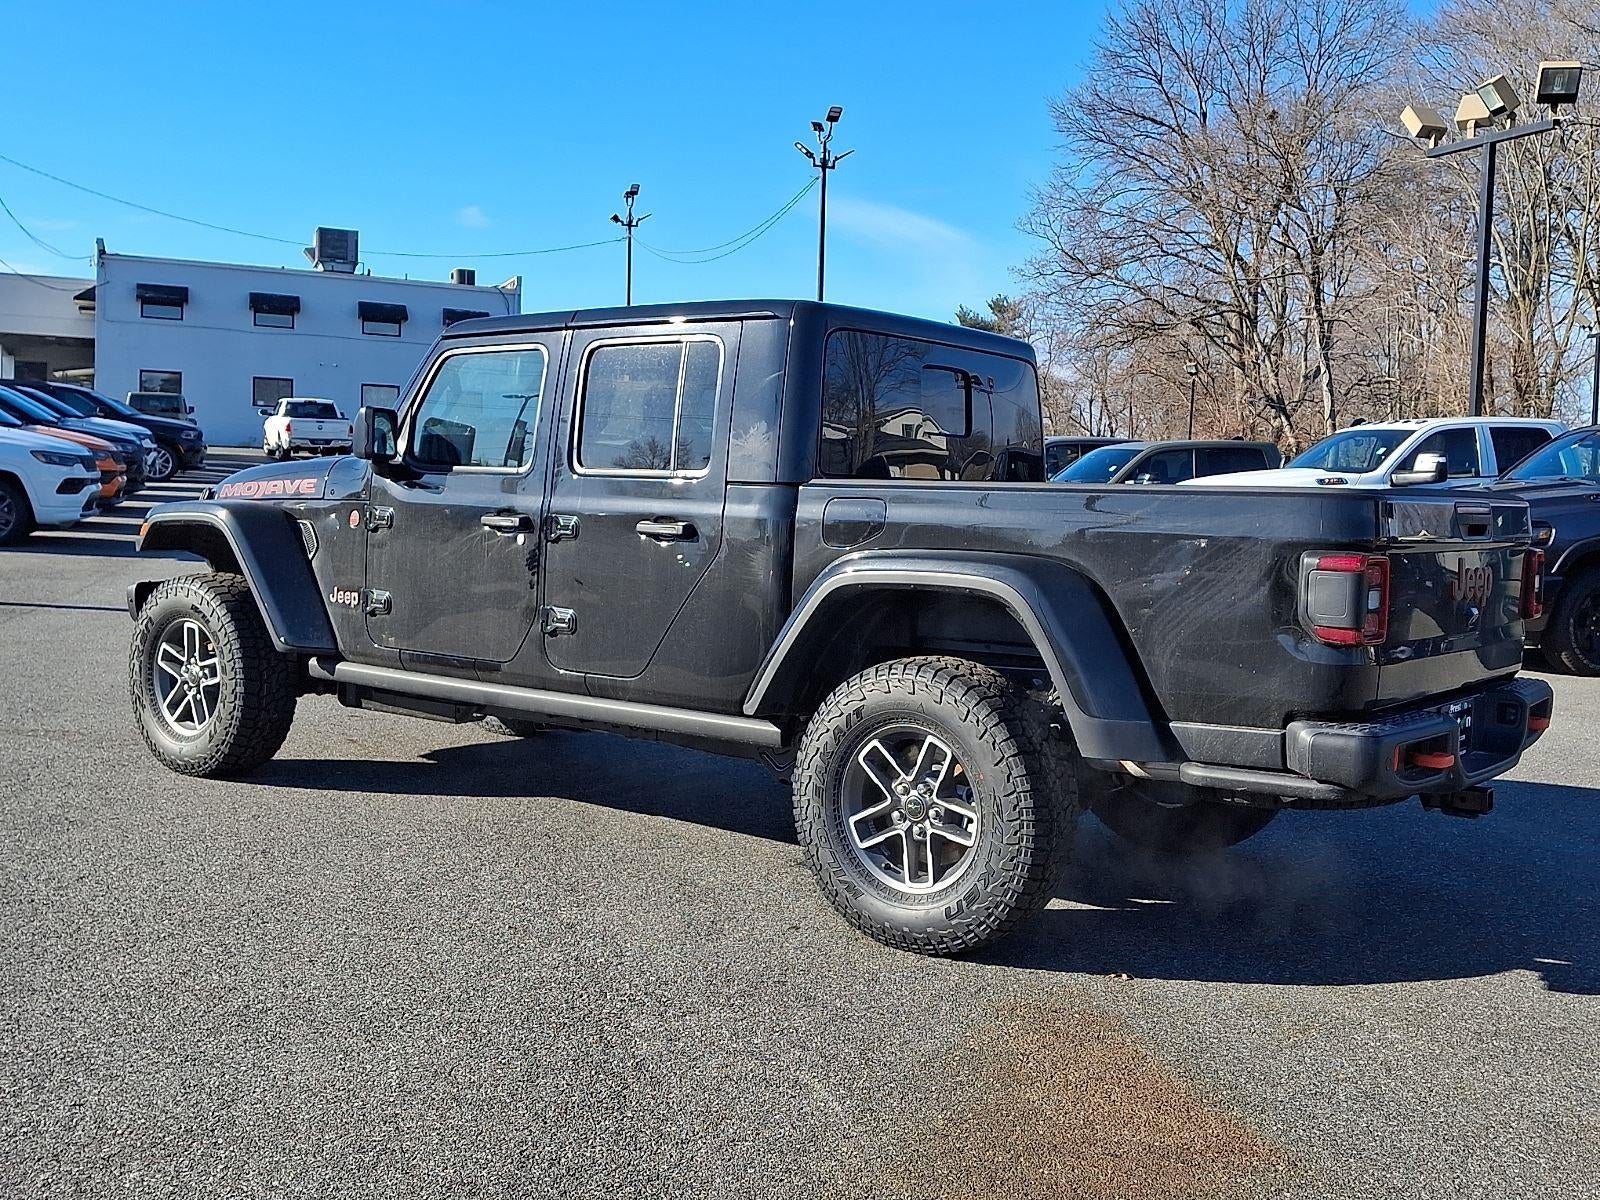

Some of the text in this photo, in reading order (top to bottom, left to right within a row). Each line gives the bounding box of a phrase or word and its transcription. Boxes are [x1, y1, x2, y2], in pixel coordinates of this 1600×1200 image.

[220, 478, 318, 498] MOJAVE
[1452, 557, 1493, 607] Jeep
[329, 586, 360, 608] Jeep
